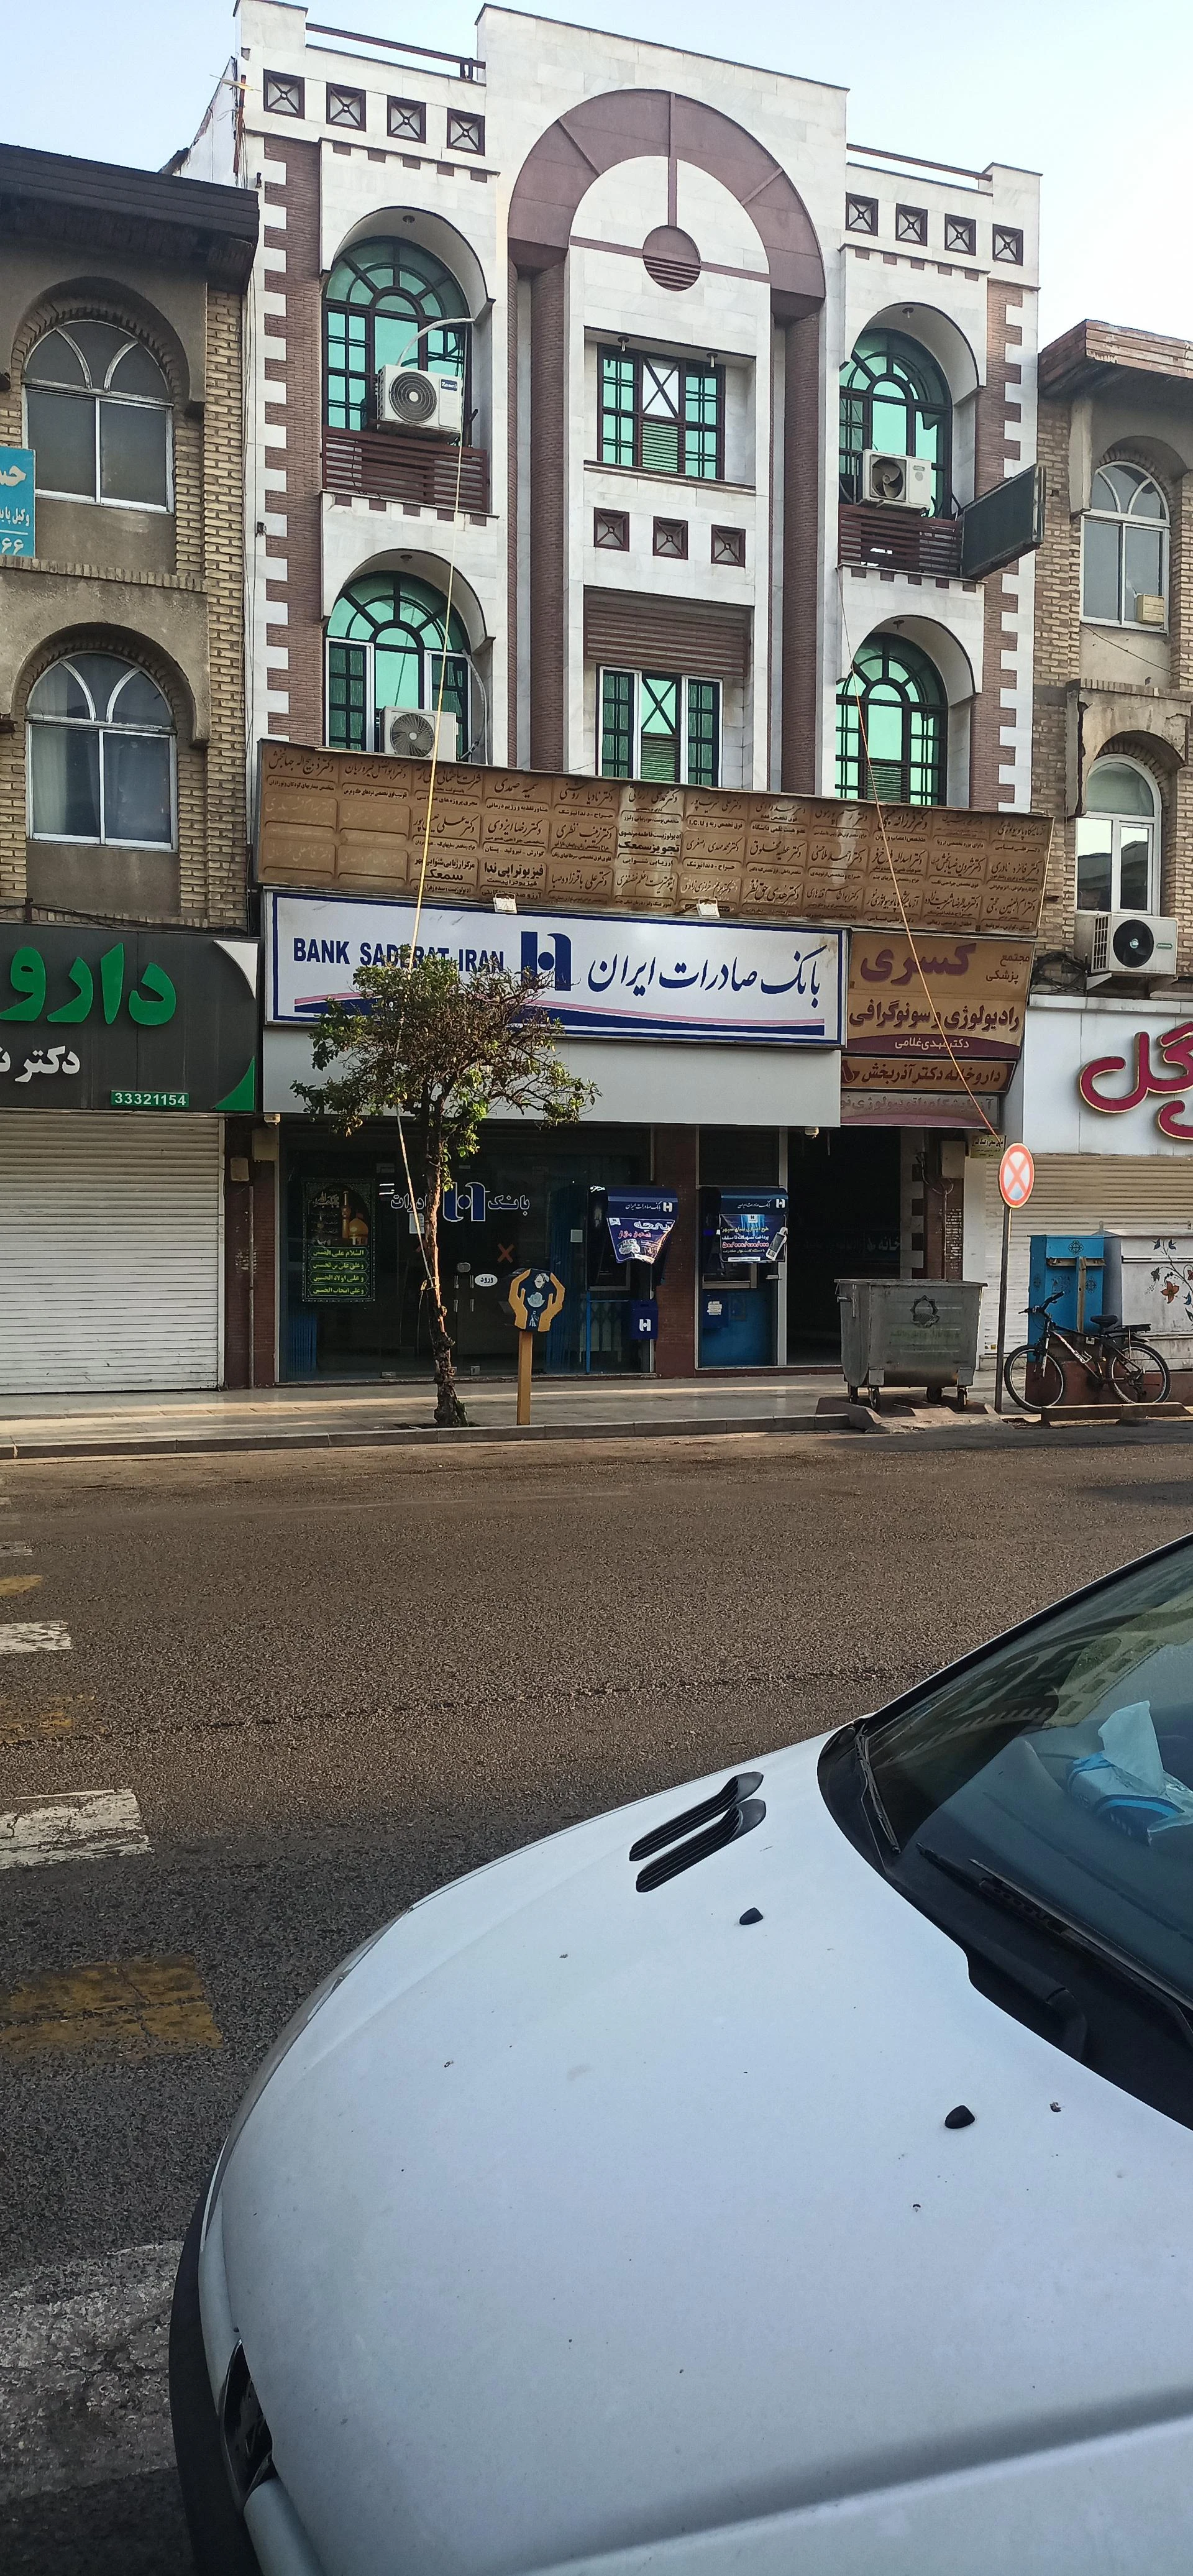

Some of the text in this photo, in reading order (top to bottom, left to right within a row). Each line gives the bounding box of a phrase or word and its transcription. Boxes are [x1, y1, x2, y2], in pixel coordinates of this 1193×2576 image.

[0, 506, 29, 526] وکیل پای
[1, 537, 24, 555] ۶۶
[316, 757, 334, 777] دکتر
[391, 764, 409, 781] دکتر
[494, 778, 520, 792] صمدی
[587, 791, 600, 804] نادیا
[596, 787, 617, 806] دکتر
[728, 796, 744, 814] دکتر
[437, 815, 466, 833] علی
[459, 815, 480, 837] دکتر
[488, 818, 543, 837] دکتر رضا ایزدی
[556, 822, 616, 845] دکتر زینب نظری
[618, 841, 680, 854] تجویز سمعک
[686, 837, 705, 851] اصغری
[726, 837, 743, 855] دکتر
[750, 840, 805, 862] دکتر عطیه مخلوق
[827, 850, 851, 861] احمد
[847, 848, 866, 868] دکتر
[894, 851, 912, 863] اسداله
[909, 850, 926, 868] دکتر
[484, 861, 544, 879] فیزیوتراپی ندا
[687, 861, 714, 869] دندانپزشک
[968, 858, 985, 876] دکتر
[991, 861, 1010, 874] نادری
[1026, 860, 1043, 877] دکتر
[420, 869, 464, 881] سمعک
[585, 874, 597, 889] علی
[592, 871, 611, 891] دکتر
[743, 879, 759, 899] نظر
[754, 882, 769, 900] حق
[781, 883, 802, 905] دکتر
[964, 895, 980, 912] دکتر
[293, 937, 350, 965] BANK
[459, 949, 504, 973] IRAN
[860, 942, 977, 986] کسری
[999, 953, 1030, 967] مجتمع
[587, 944, 827, 1009] بانک صادرات ایران
[985, 969, 1019, 984] پزشکی
[849, 999, 1020, 1032] رادیولوژی و سونوگرافی
[895, 1037, 921, 1049] غلامی
[948, 1038, 970, 1049] دکتر
[14, 1045, 80, 1083] دکتر
[861, 1061, 1001, 1085] داروخانه دکتر آذربخش
[114, 1092, 186, 1106] 33321154
[390, 1193, 530, 1216] بانک ادرات
[625, 1203, 636, 1211] ایران
[651, 1201, 662, 1211] بانک
[333, 1275, 346, 1283] اولاد
